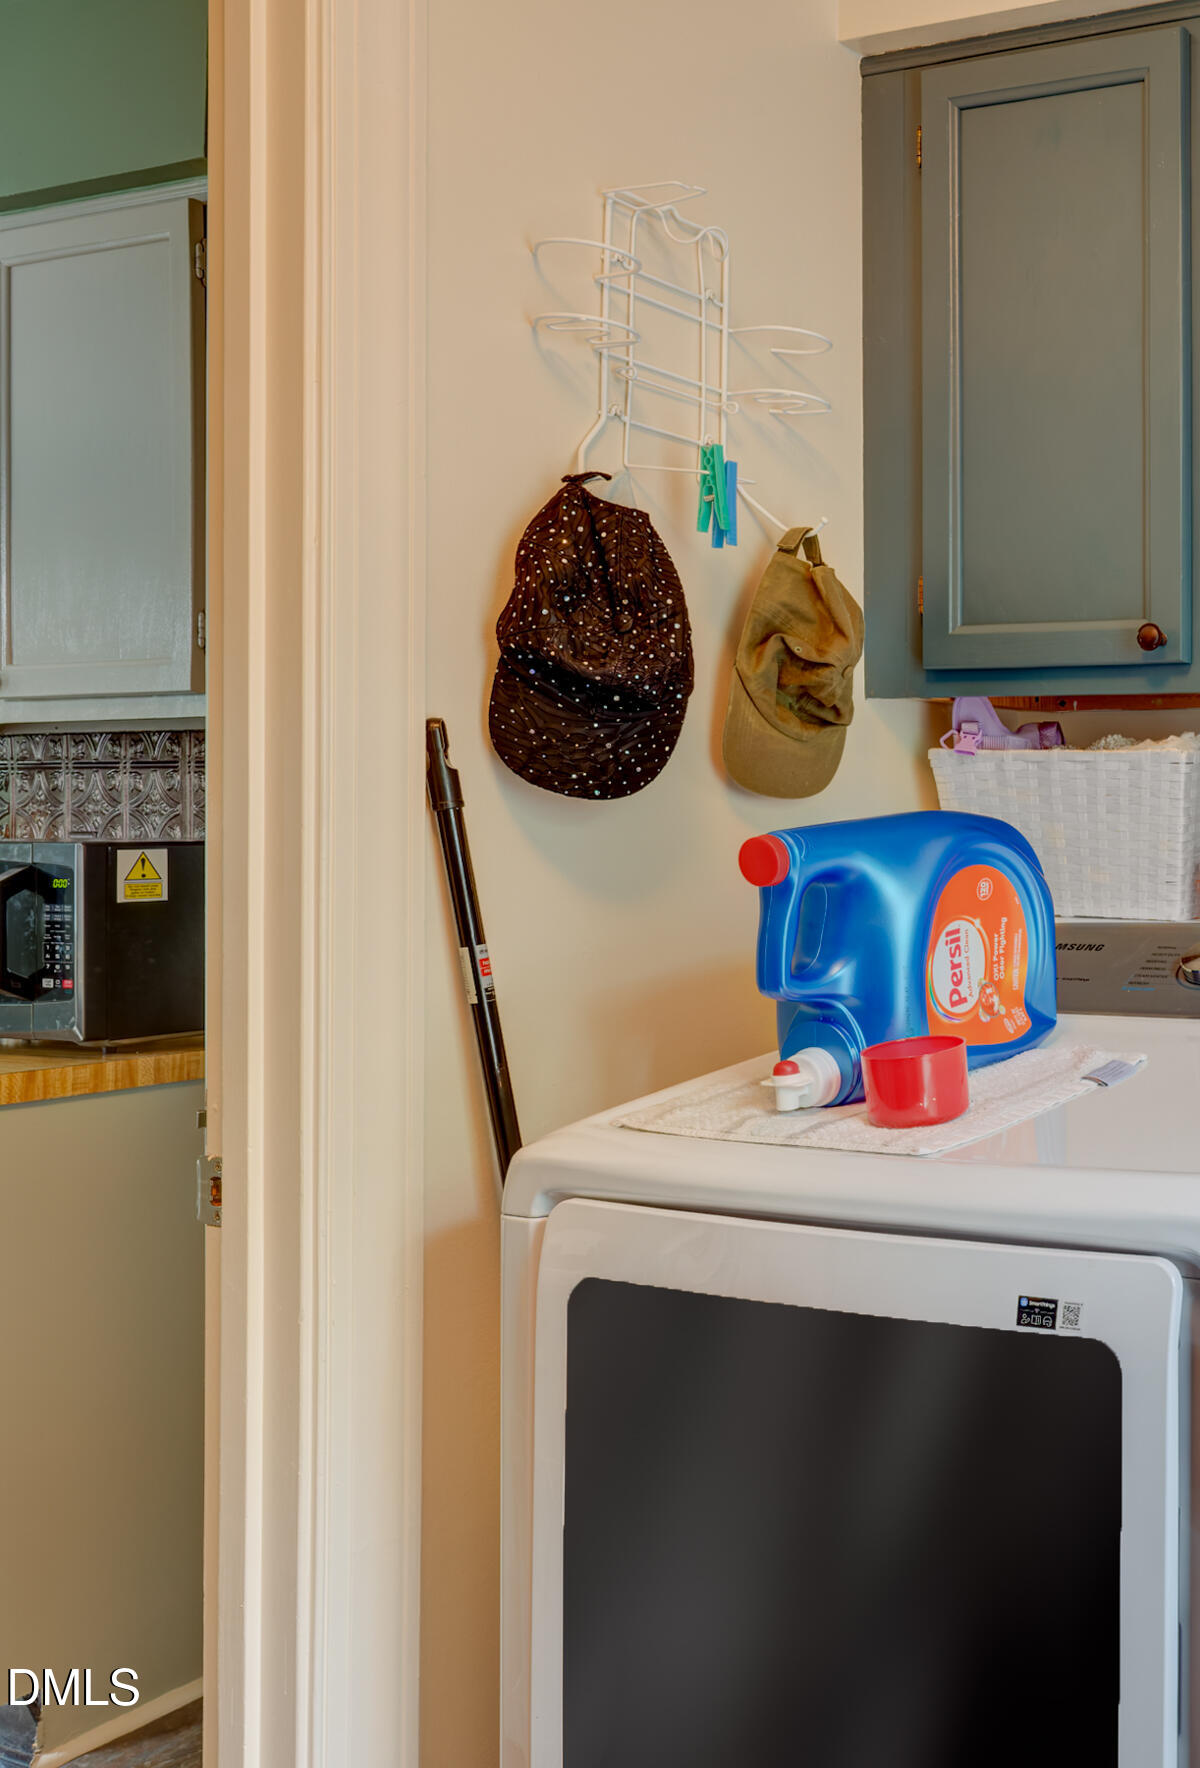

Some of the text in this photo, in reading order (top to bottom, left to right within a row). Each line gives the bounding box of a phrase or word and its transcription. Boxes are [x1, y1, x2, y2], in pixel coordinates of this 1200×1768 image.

[999, 917, 1008, 954] Fighting
[1056, 943, 1105, 952] MSUNG
[945, 928, 968, 1008] Persil
[964, 956, 973, 998] Advanced
